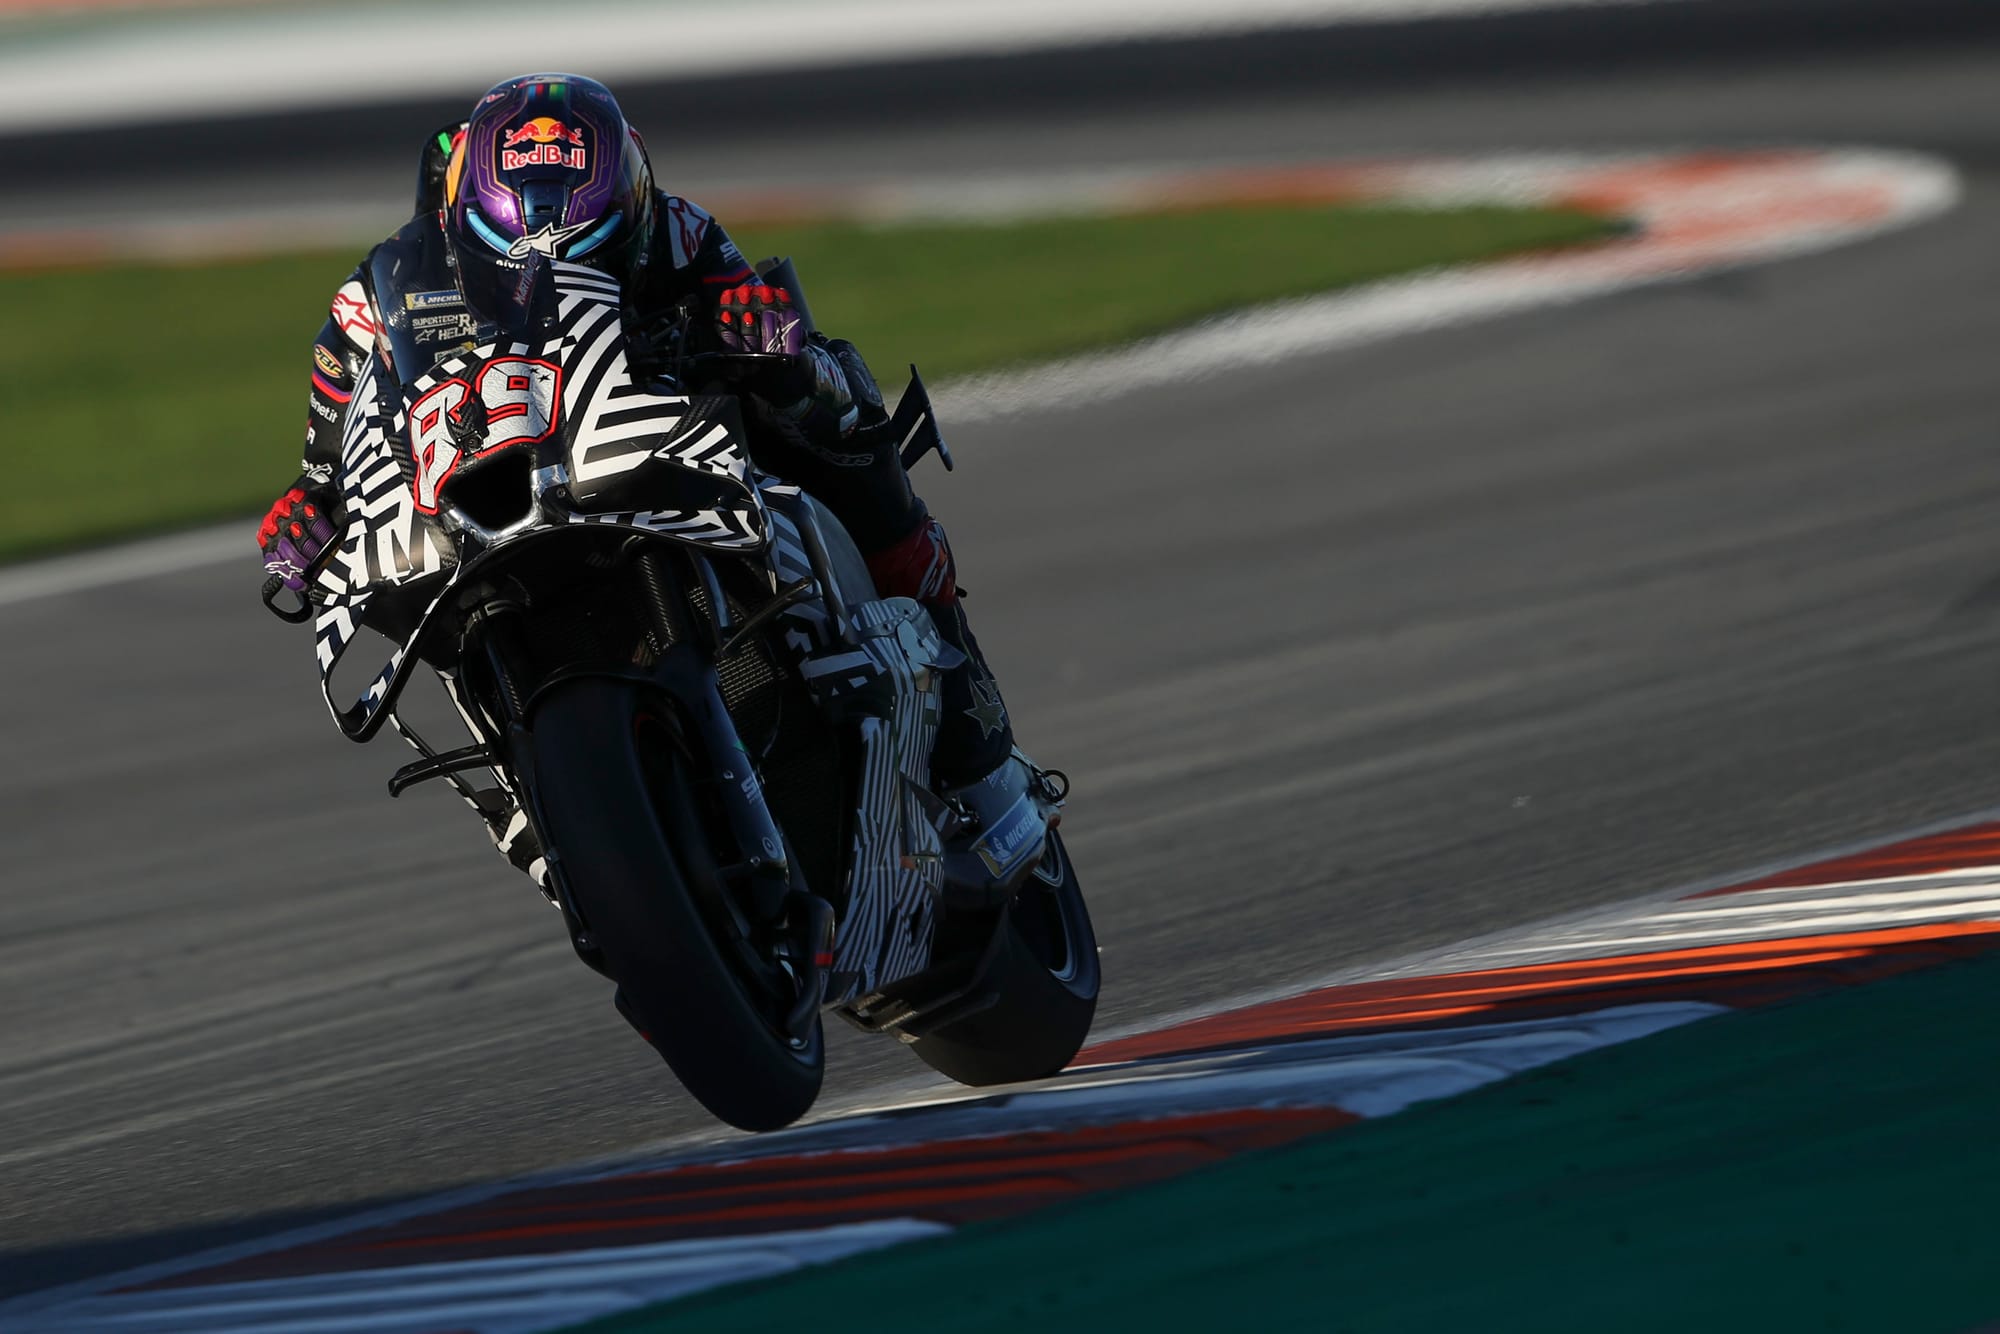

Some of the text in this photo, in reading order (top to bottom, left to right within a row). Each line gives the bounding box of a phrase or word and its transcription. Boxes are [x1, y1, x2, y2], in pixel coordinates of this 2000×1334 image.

[502, 144, 586, 170] Red Bull
[412, 314, 458, 327] SUPERTECH
